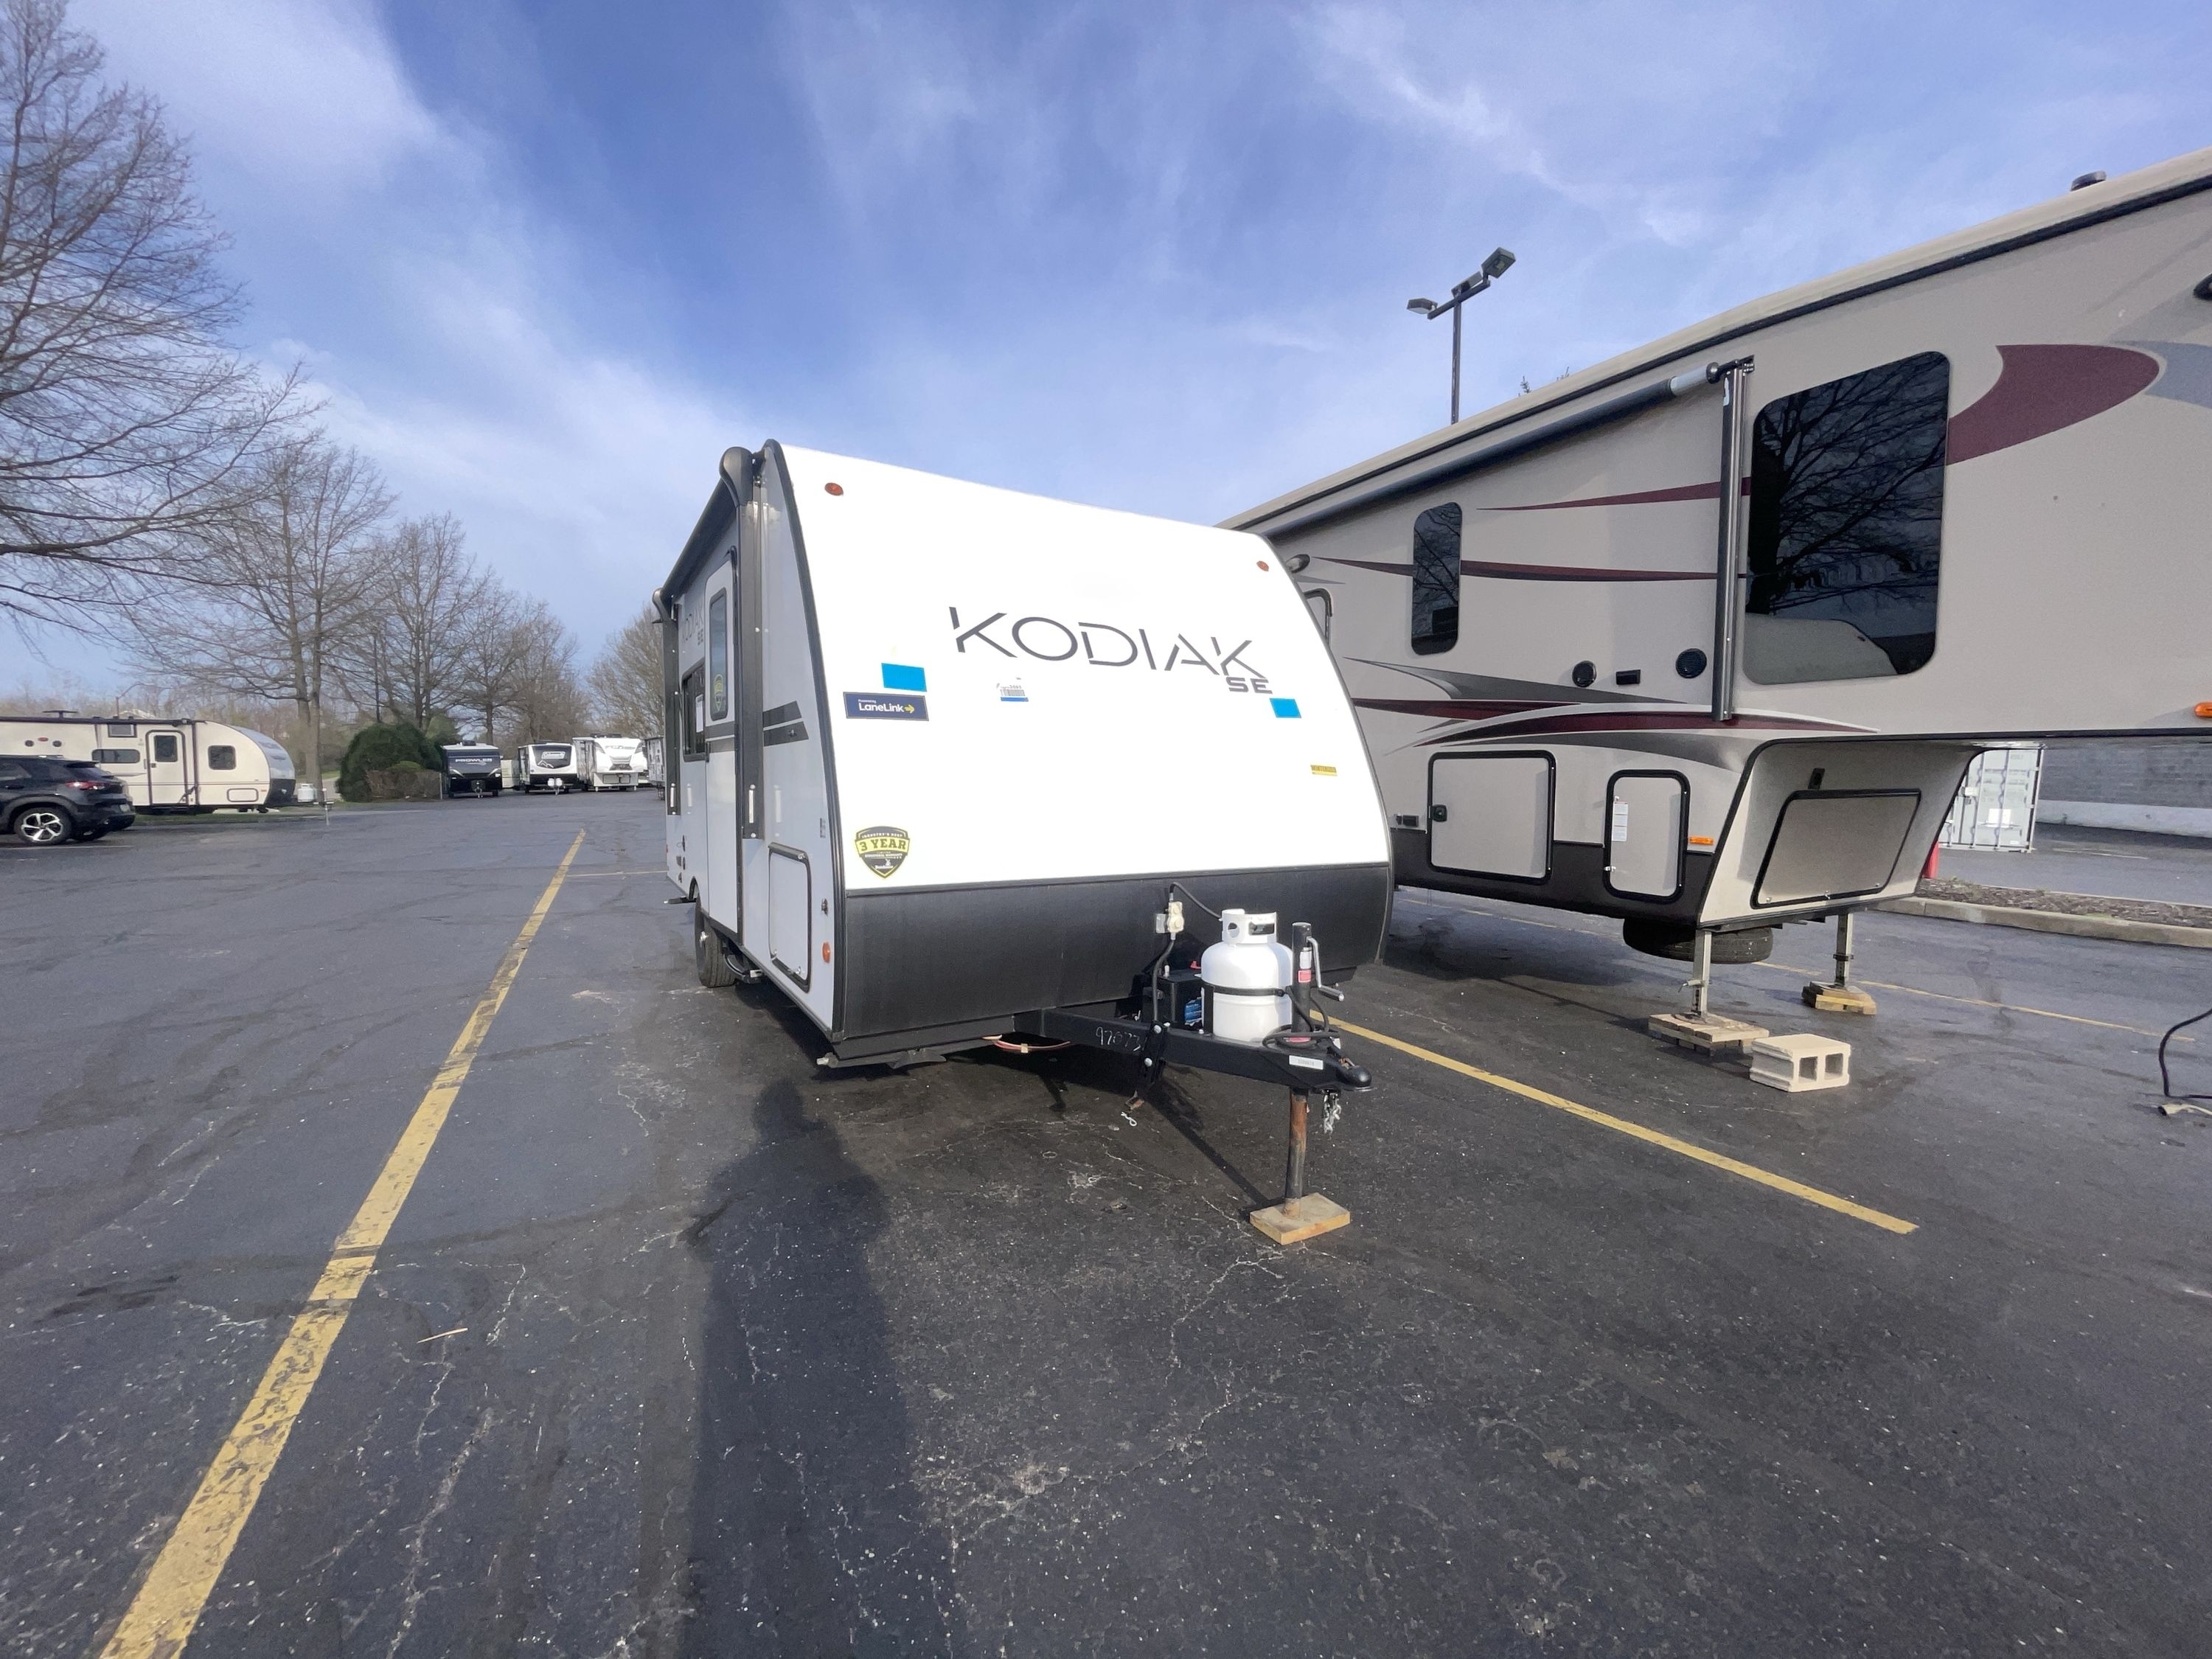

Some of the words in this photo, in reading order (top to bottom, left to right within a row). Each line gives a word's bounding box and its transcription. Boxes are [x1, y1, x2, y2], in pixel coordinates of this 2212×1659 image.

[949, 607, 1267, 679] KODIAK
[1226, 676, 1273, 695] SE
[858, 702, 905, 713] LaneLink
[859, 841, 868, 852] 3
[870, 838, 906, 849] YEAR
